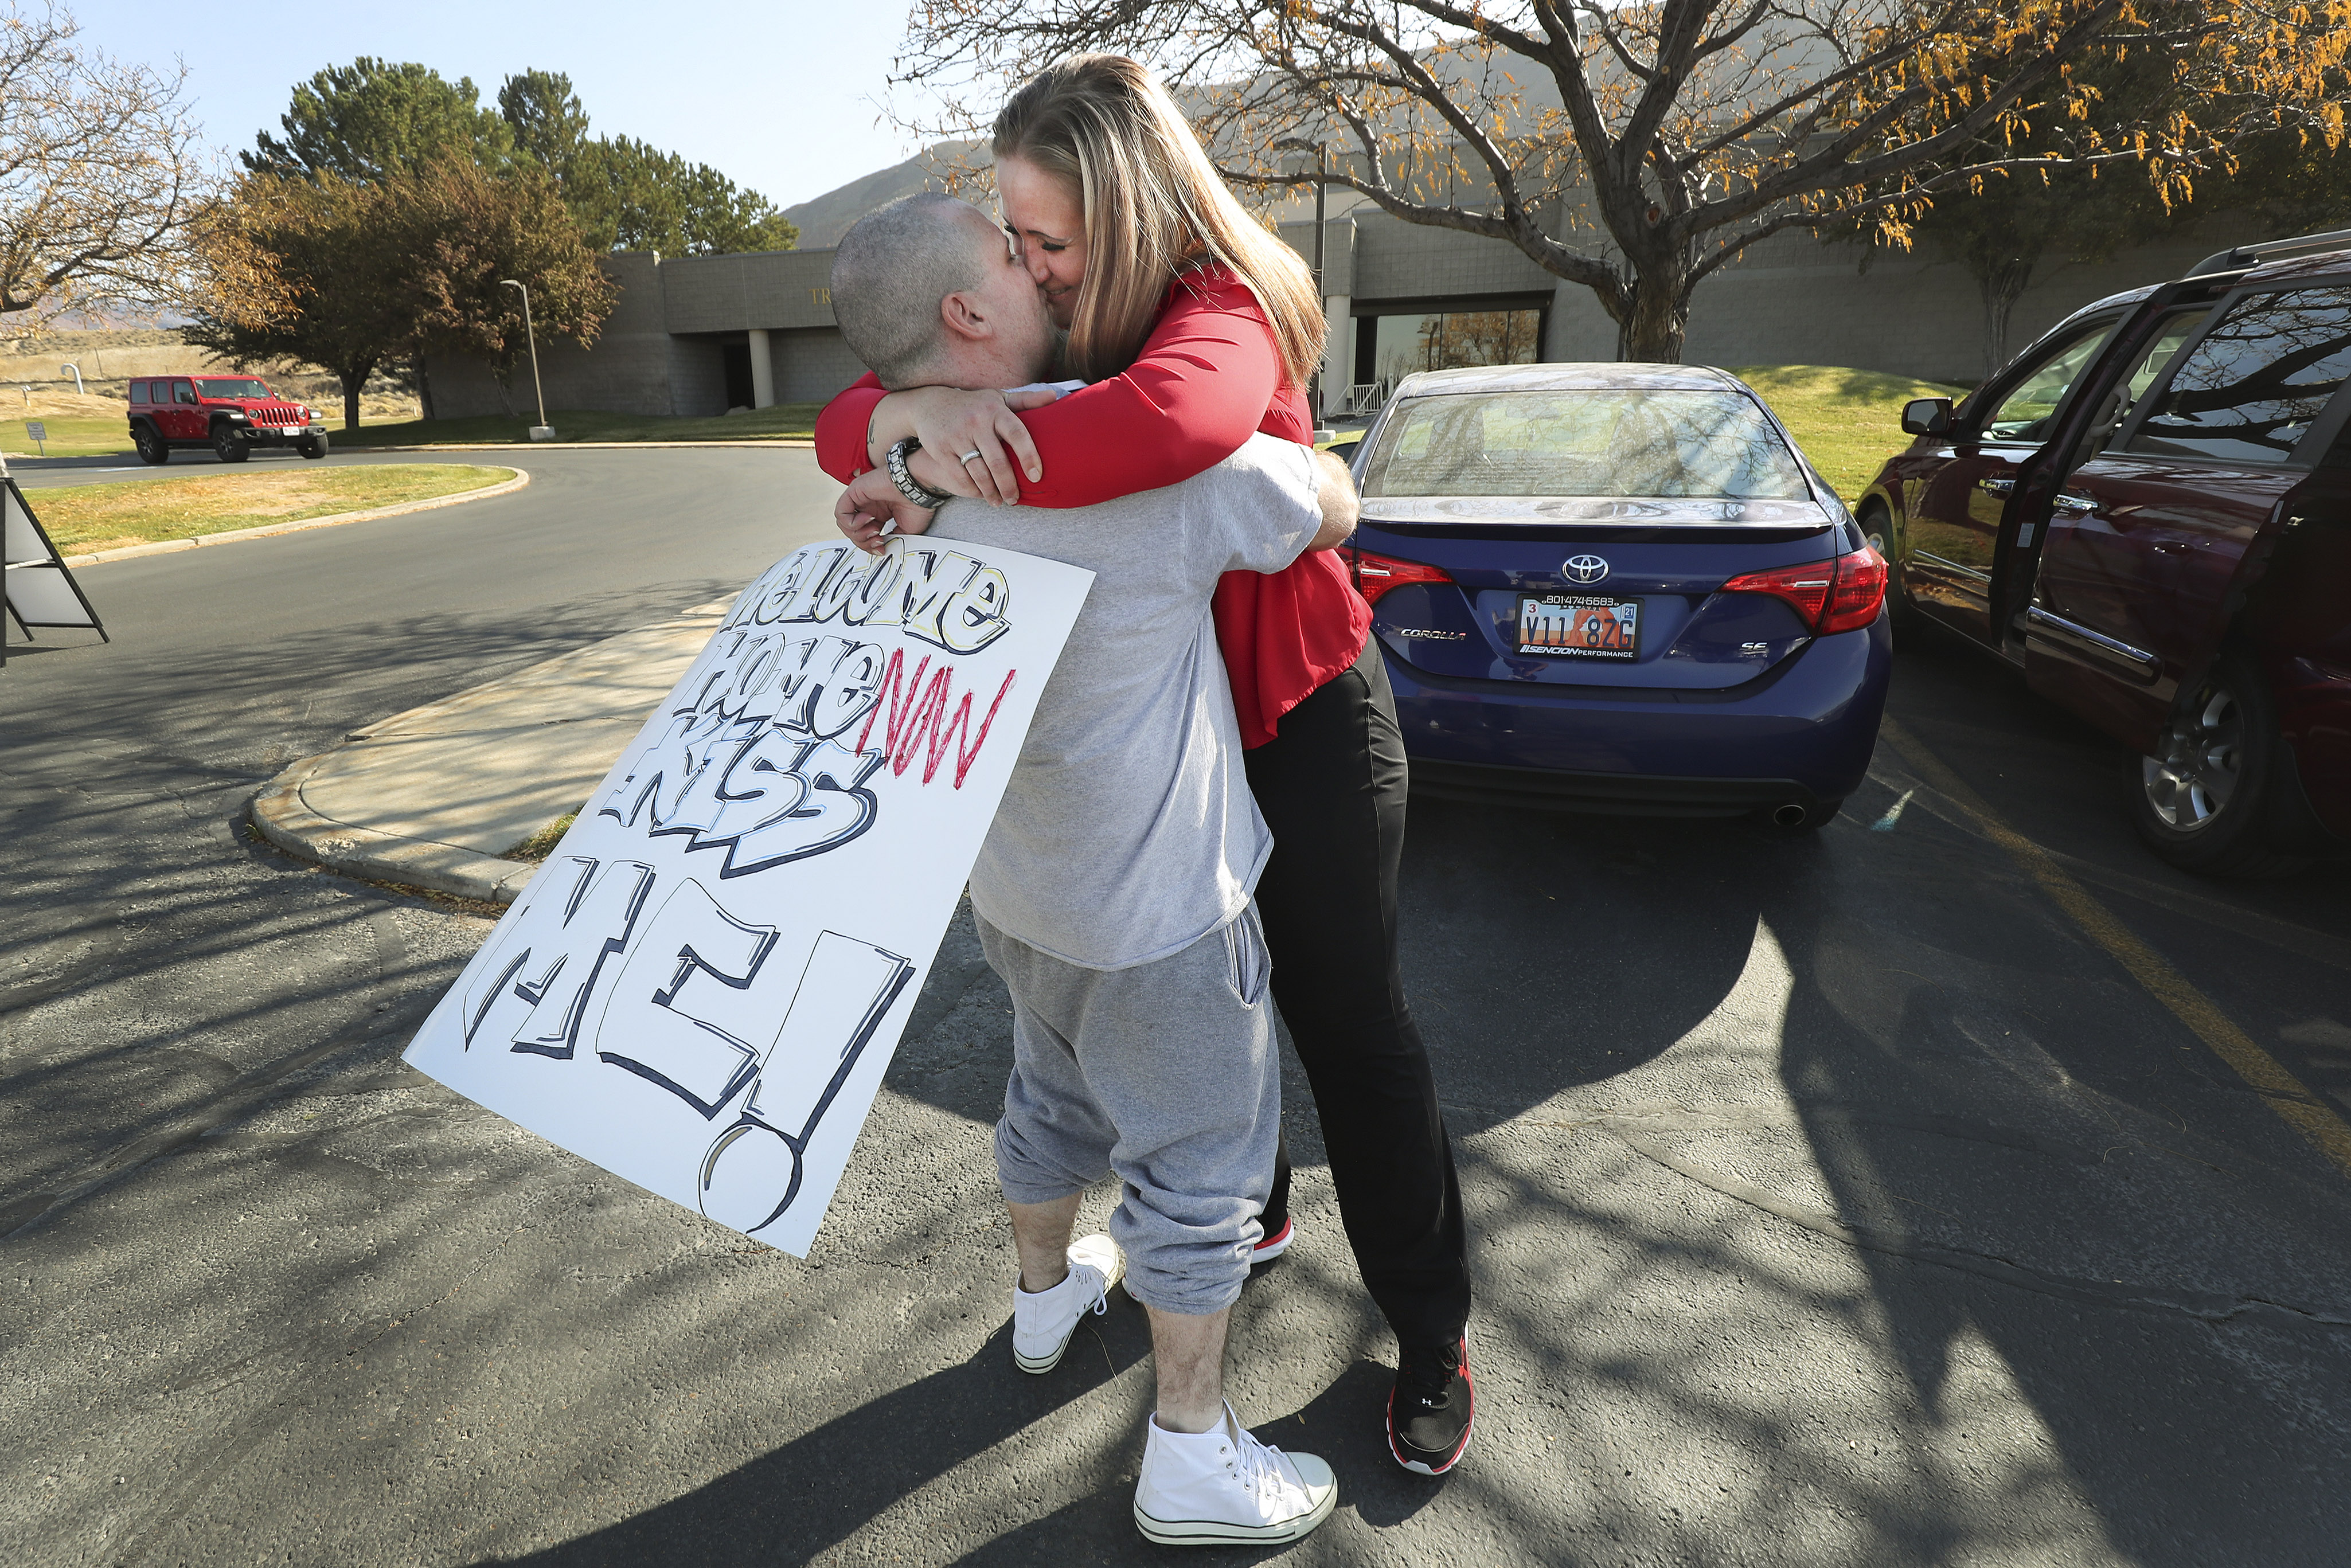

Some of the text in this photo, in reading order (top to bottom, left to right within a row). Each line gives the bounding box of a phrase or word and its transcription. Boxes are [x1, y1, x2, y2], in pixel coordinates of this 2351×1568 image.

[1528, 604, 1536, 613] 3
[1625, 607, 1634, 616] 21
[1400, 628, 1466, 640] COROLLA
[1741, 642, 1767, 651] SE
[1578, 650, 1634, 658] PERFORMANCE
